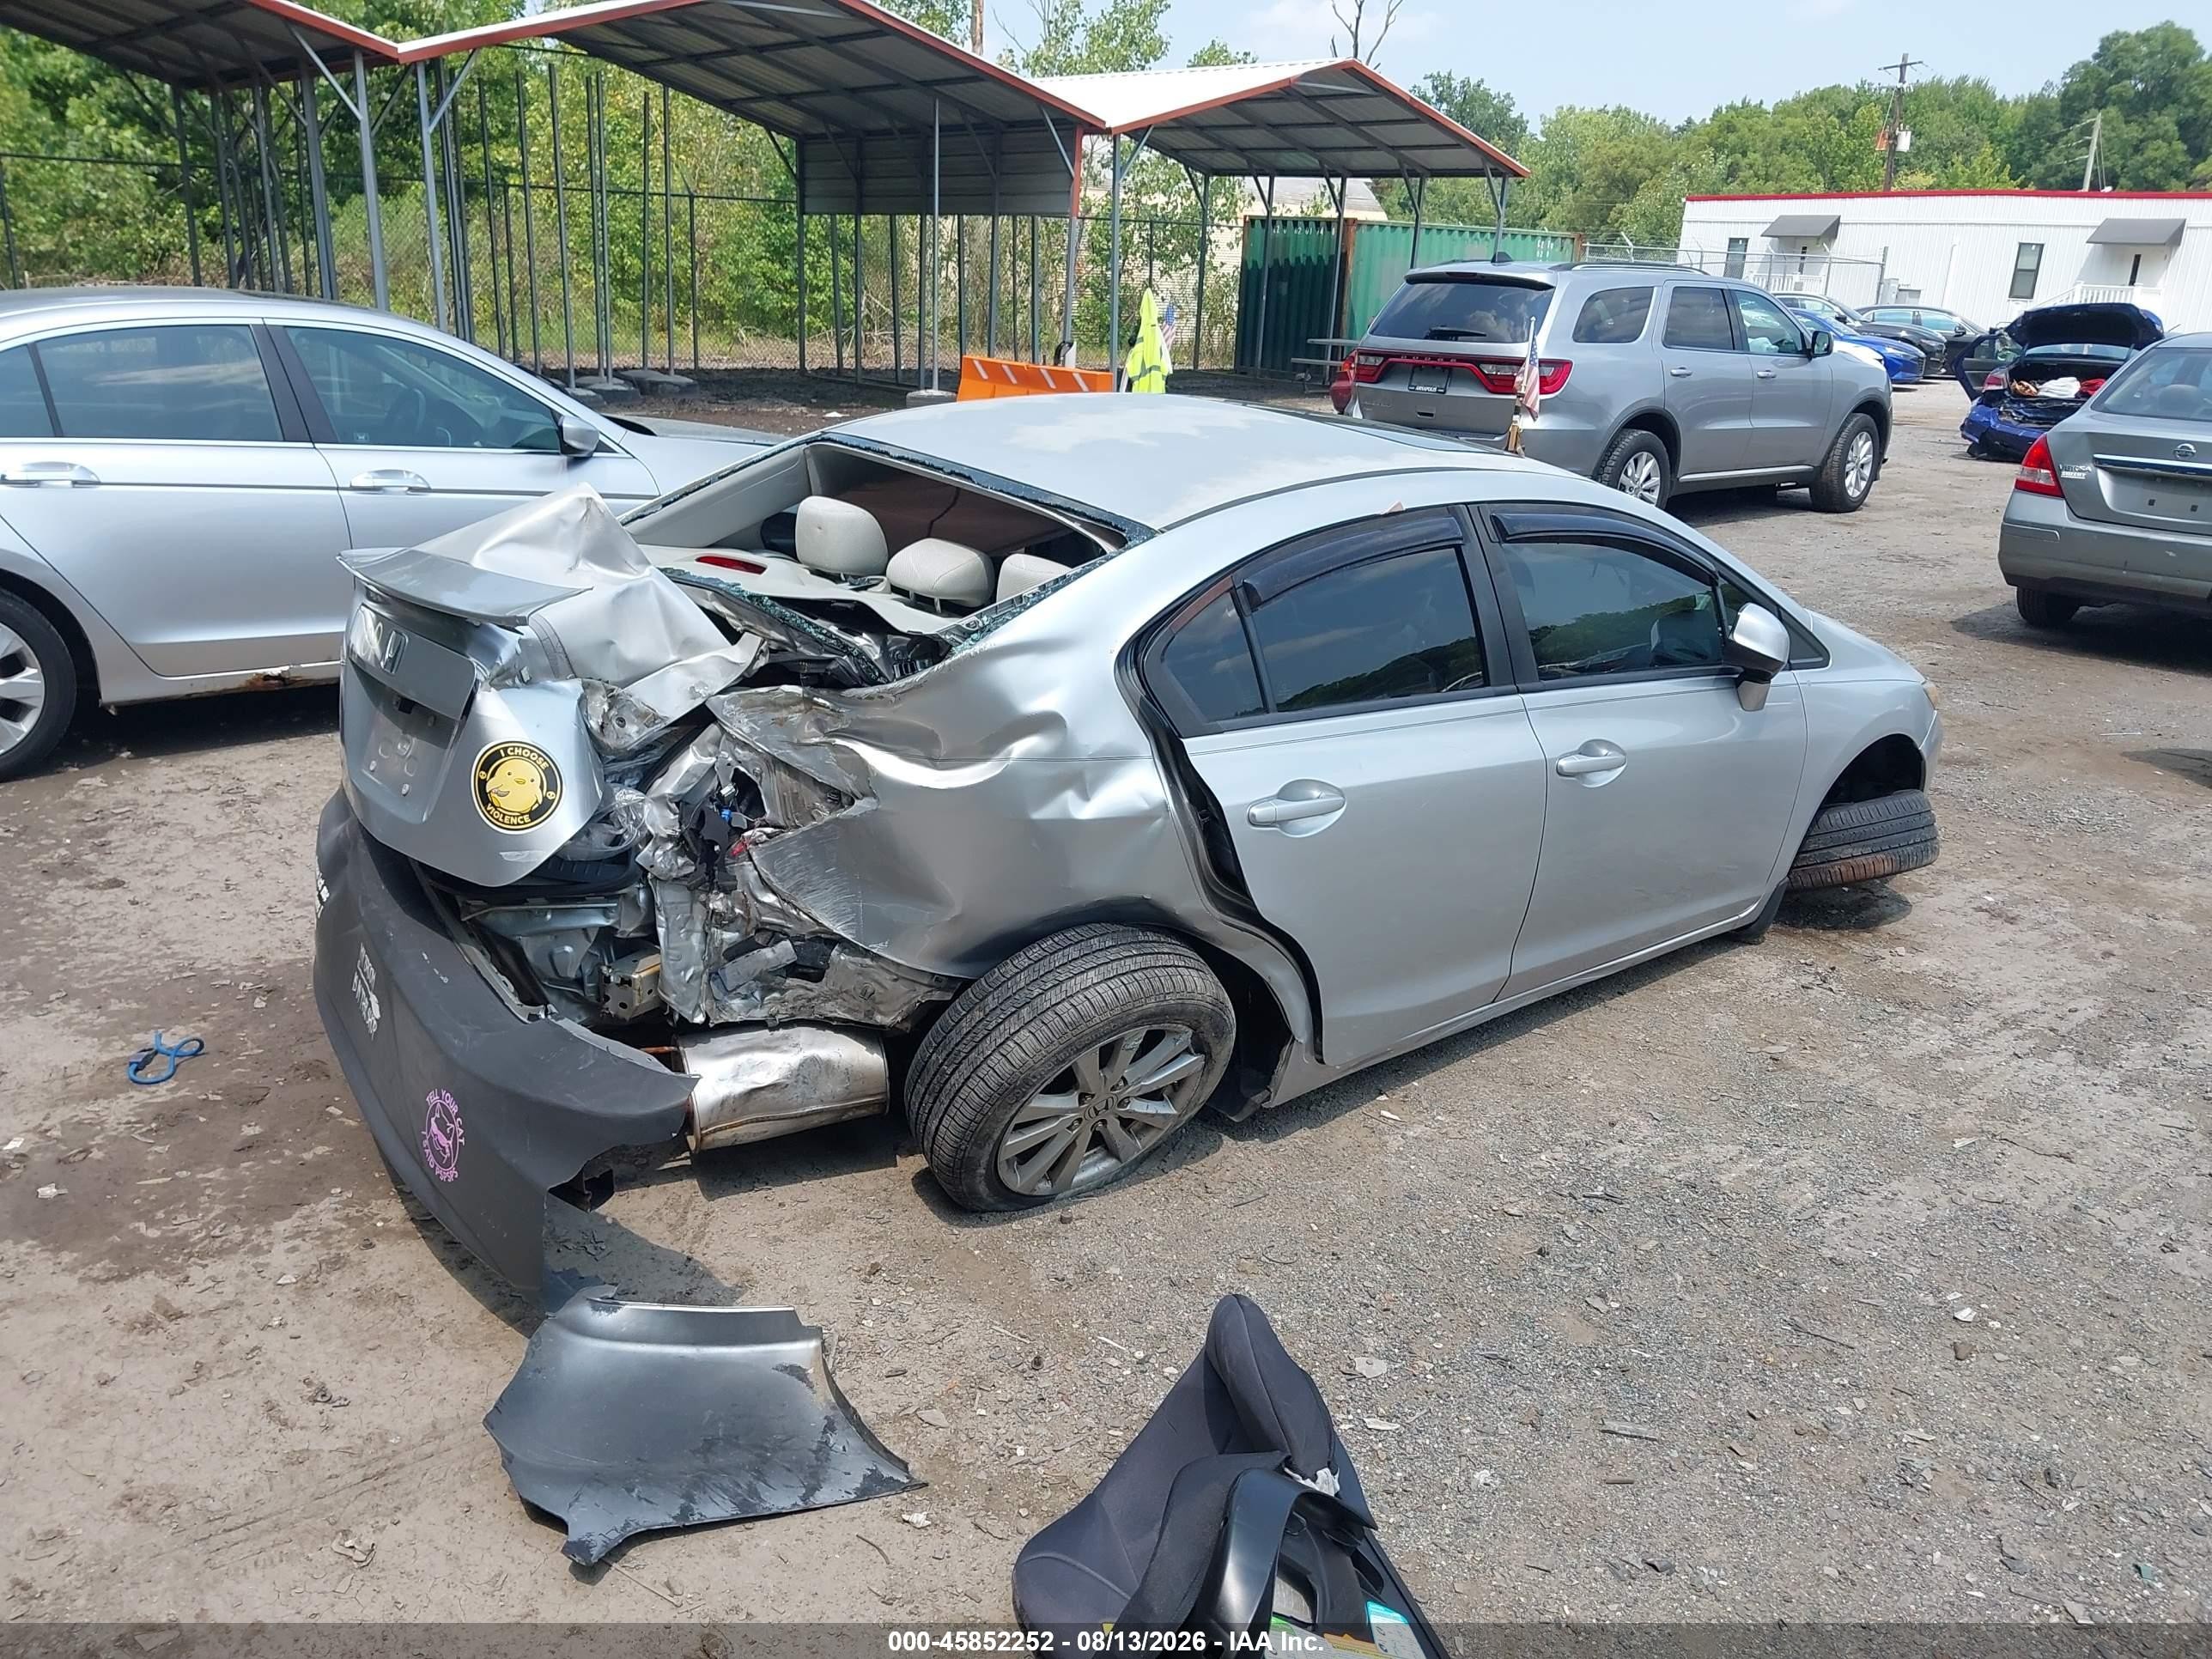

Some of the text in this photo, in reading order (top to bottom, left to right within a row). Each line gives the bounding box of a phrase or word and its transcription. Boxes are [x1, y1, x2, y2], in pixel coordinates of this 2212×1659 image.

[500, 747, 550, 770] I CHOOSE
[486, 803, 532, 825] VIOLENCE
[426, 1088, 465, 1146] TELL YOUR CAT
